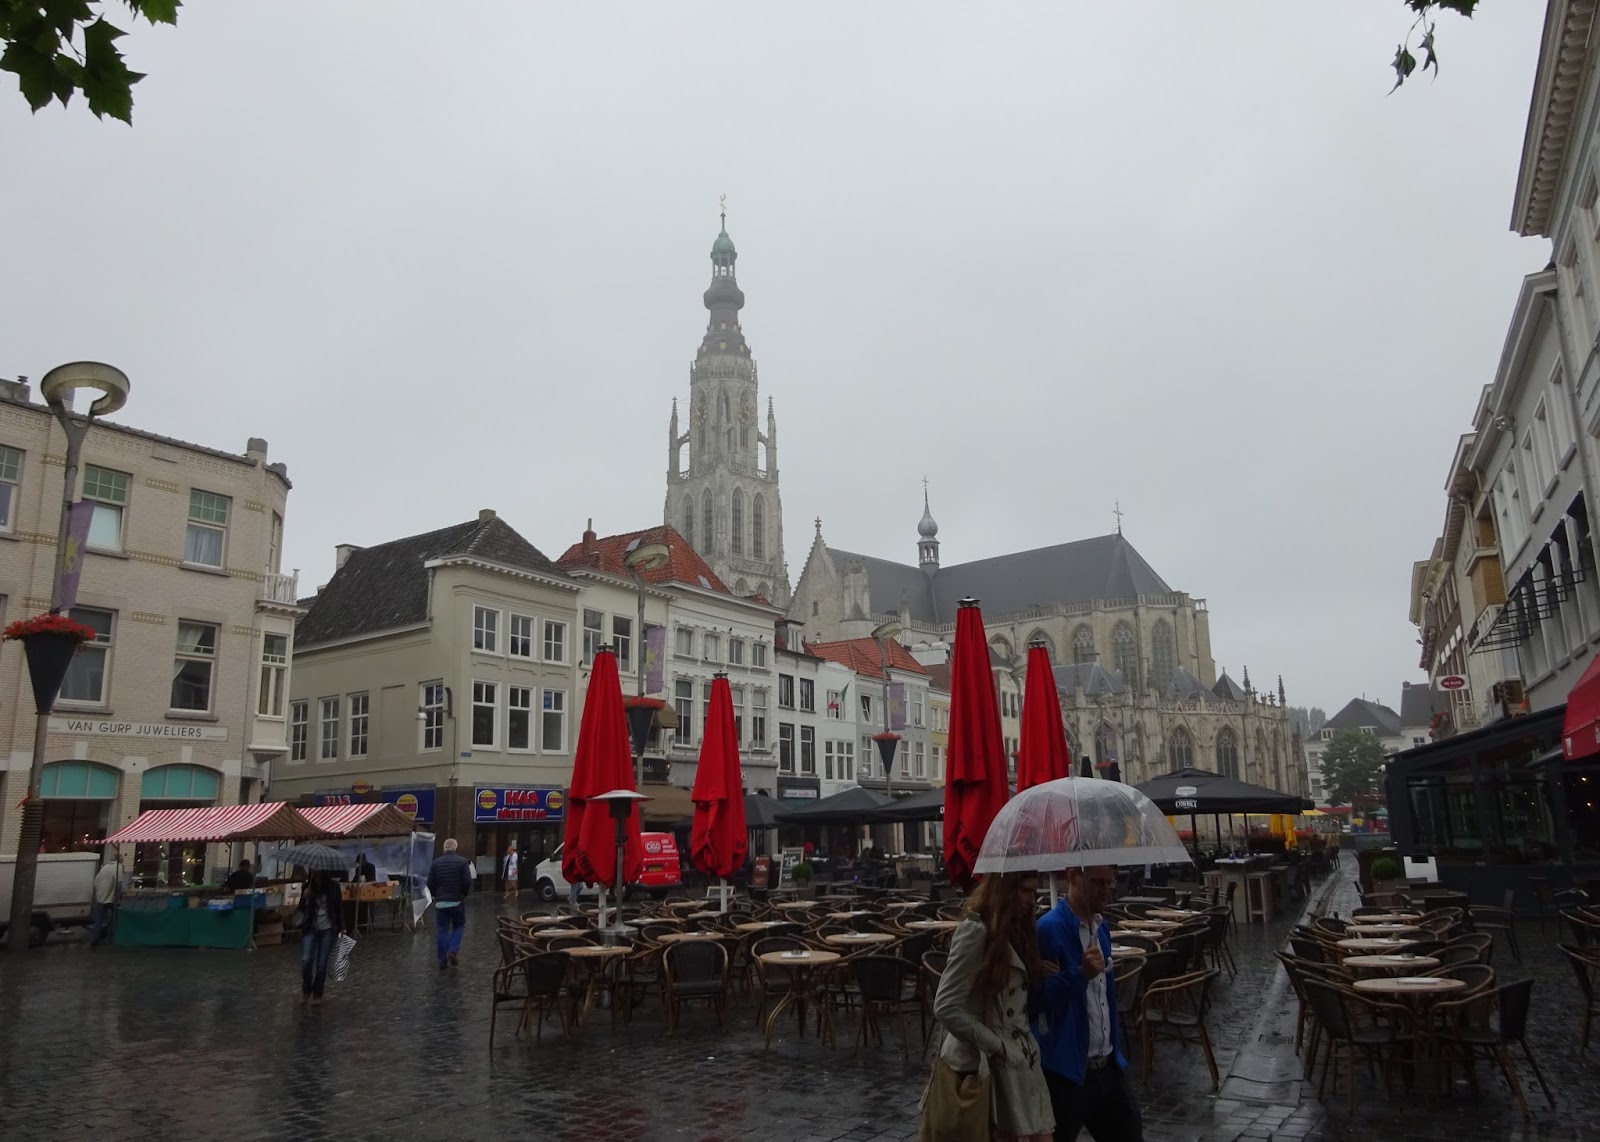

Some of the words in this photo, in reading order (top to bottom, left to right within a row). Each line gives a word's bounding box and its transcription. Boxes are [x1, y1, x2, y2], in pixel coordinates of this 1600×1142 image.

[67, 719, 93, 732] VAN
[99, 721, 132, 734] GURP
[136, 723, 202, 738] JUWELIERS
[504, 790, 539, 805] HAS
